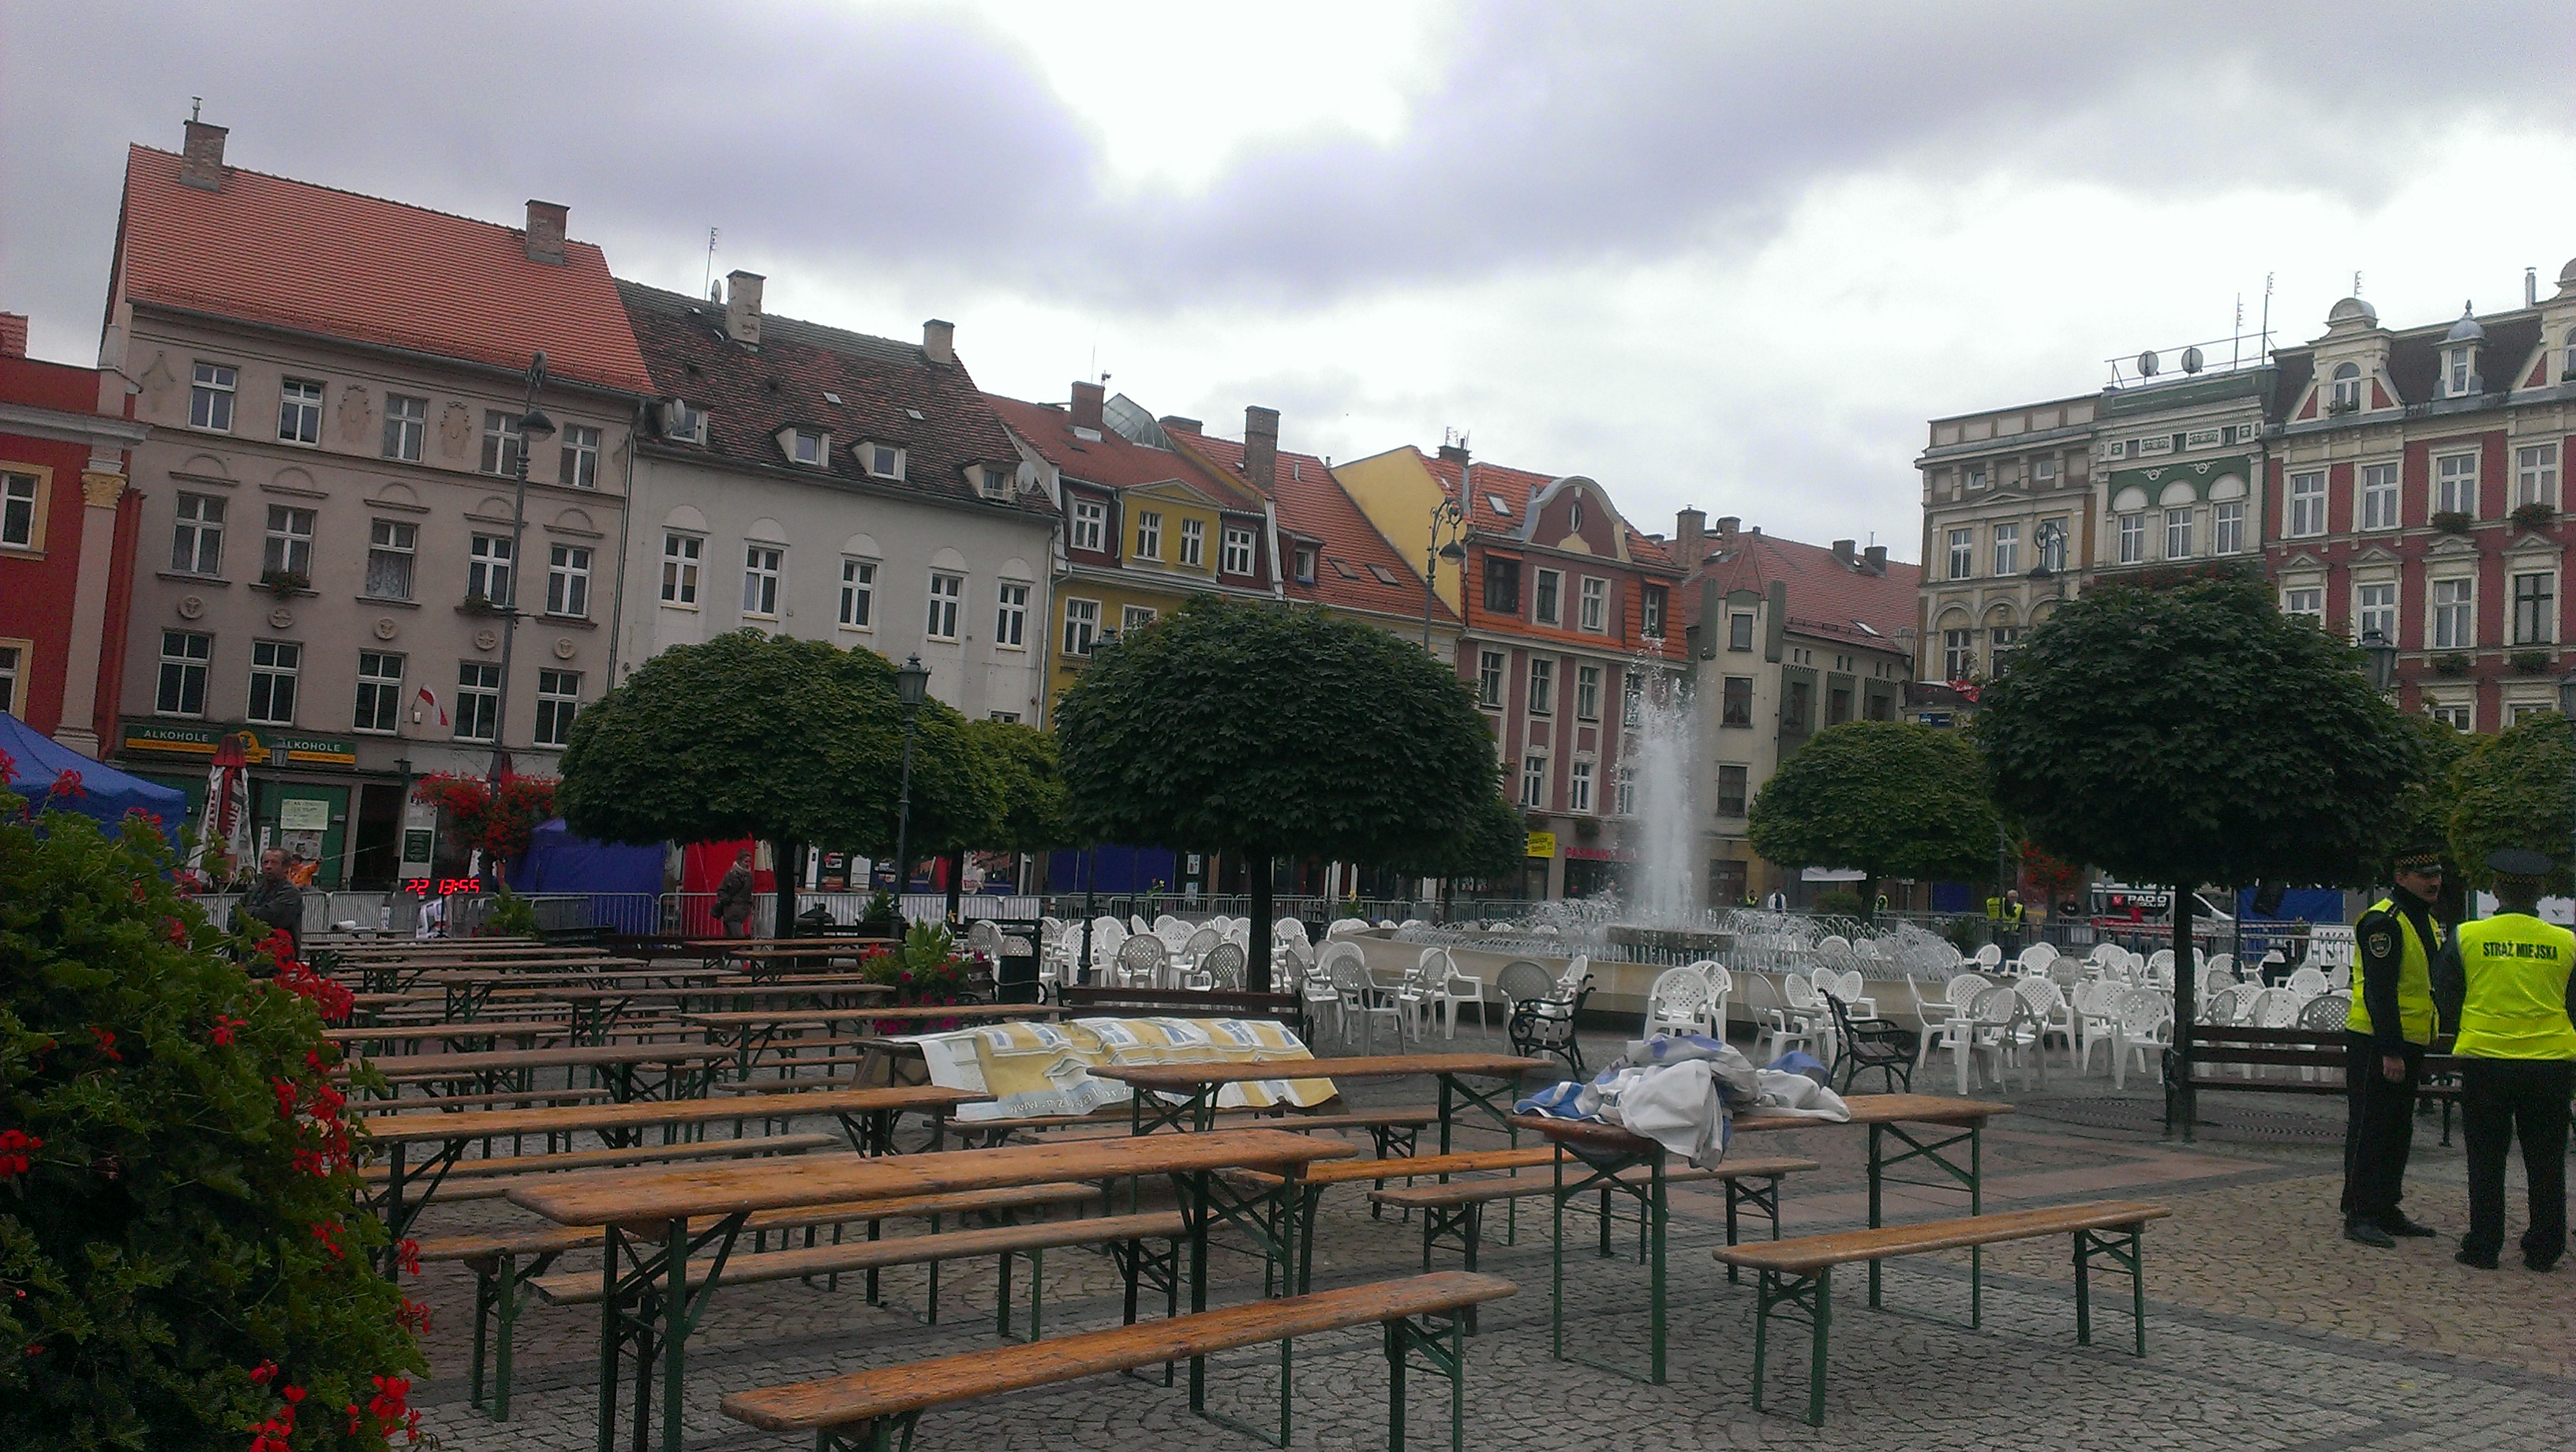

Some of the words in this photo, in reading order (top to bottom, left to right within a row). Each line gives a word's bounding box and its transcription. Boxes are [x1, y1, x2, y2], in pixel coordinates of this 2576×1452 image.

[144, 729, 209, 743] ALKOHOLE
[438, 879, 480, 896] 13:55
[2483, 940, 2514, 957] STRAŻ
[2516, 943, 2558, 960] MIEJSKA
